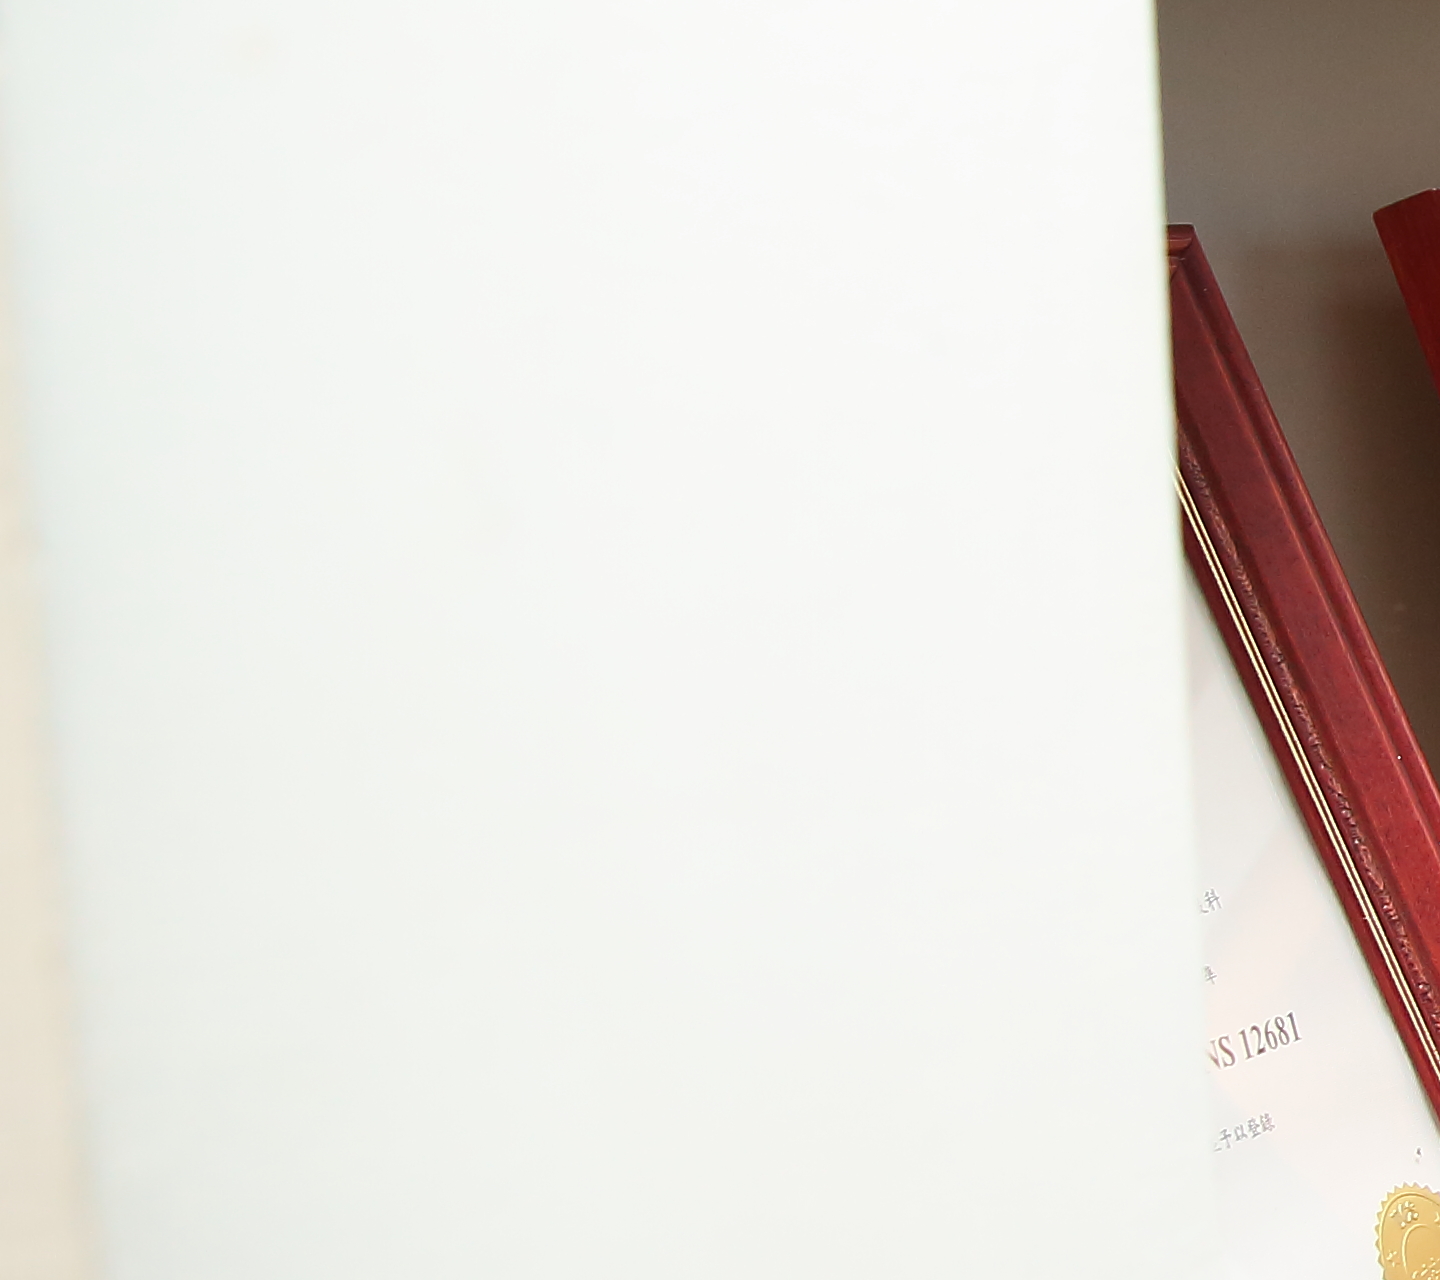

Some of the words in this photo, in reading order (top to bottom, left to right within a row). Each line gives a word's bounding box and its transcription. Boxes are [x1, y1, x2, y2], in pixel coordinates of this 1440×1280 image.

[1238, 1011, 1302, 1061] 12681
[1213, 1113, 1276, 1152] 予以登錄
